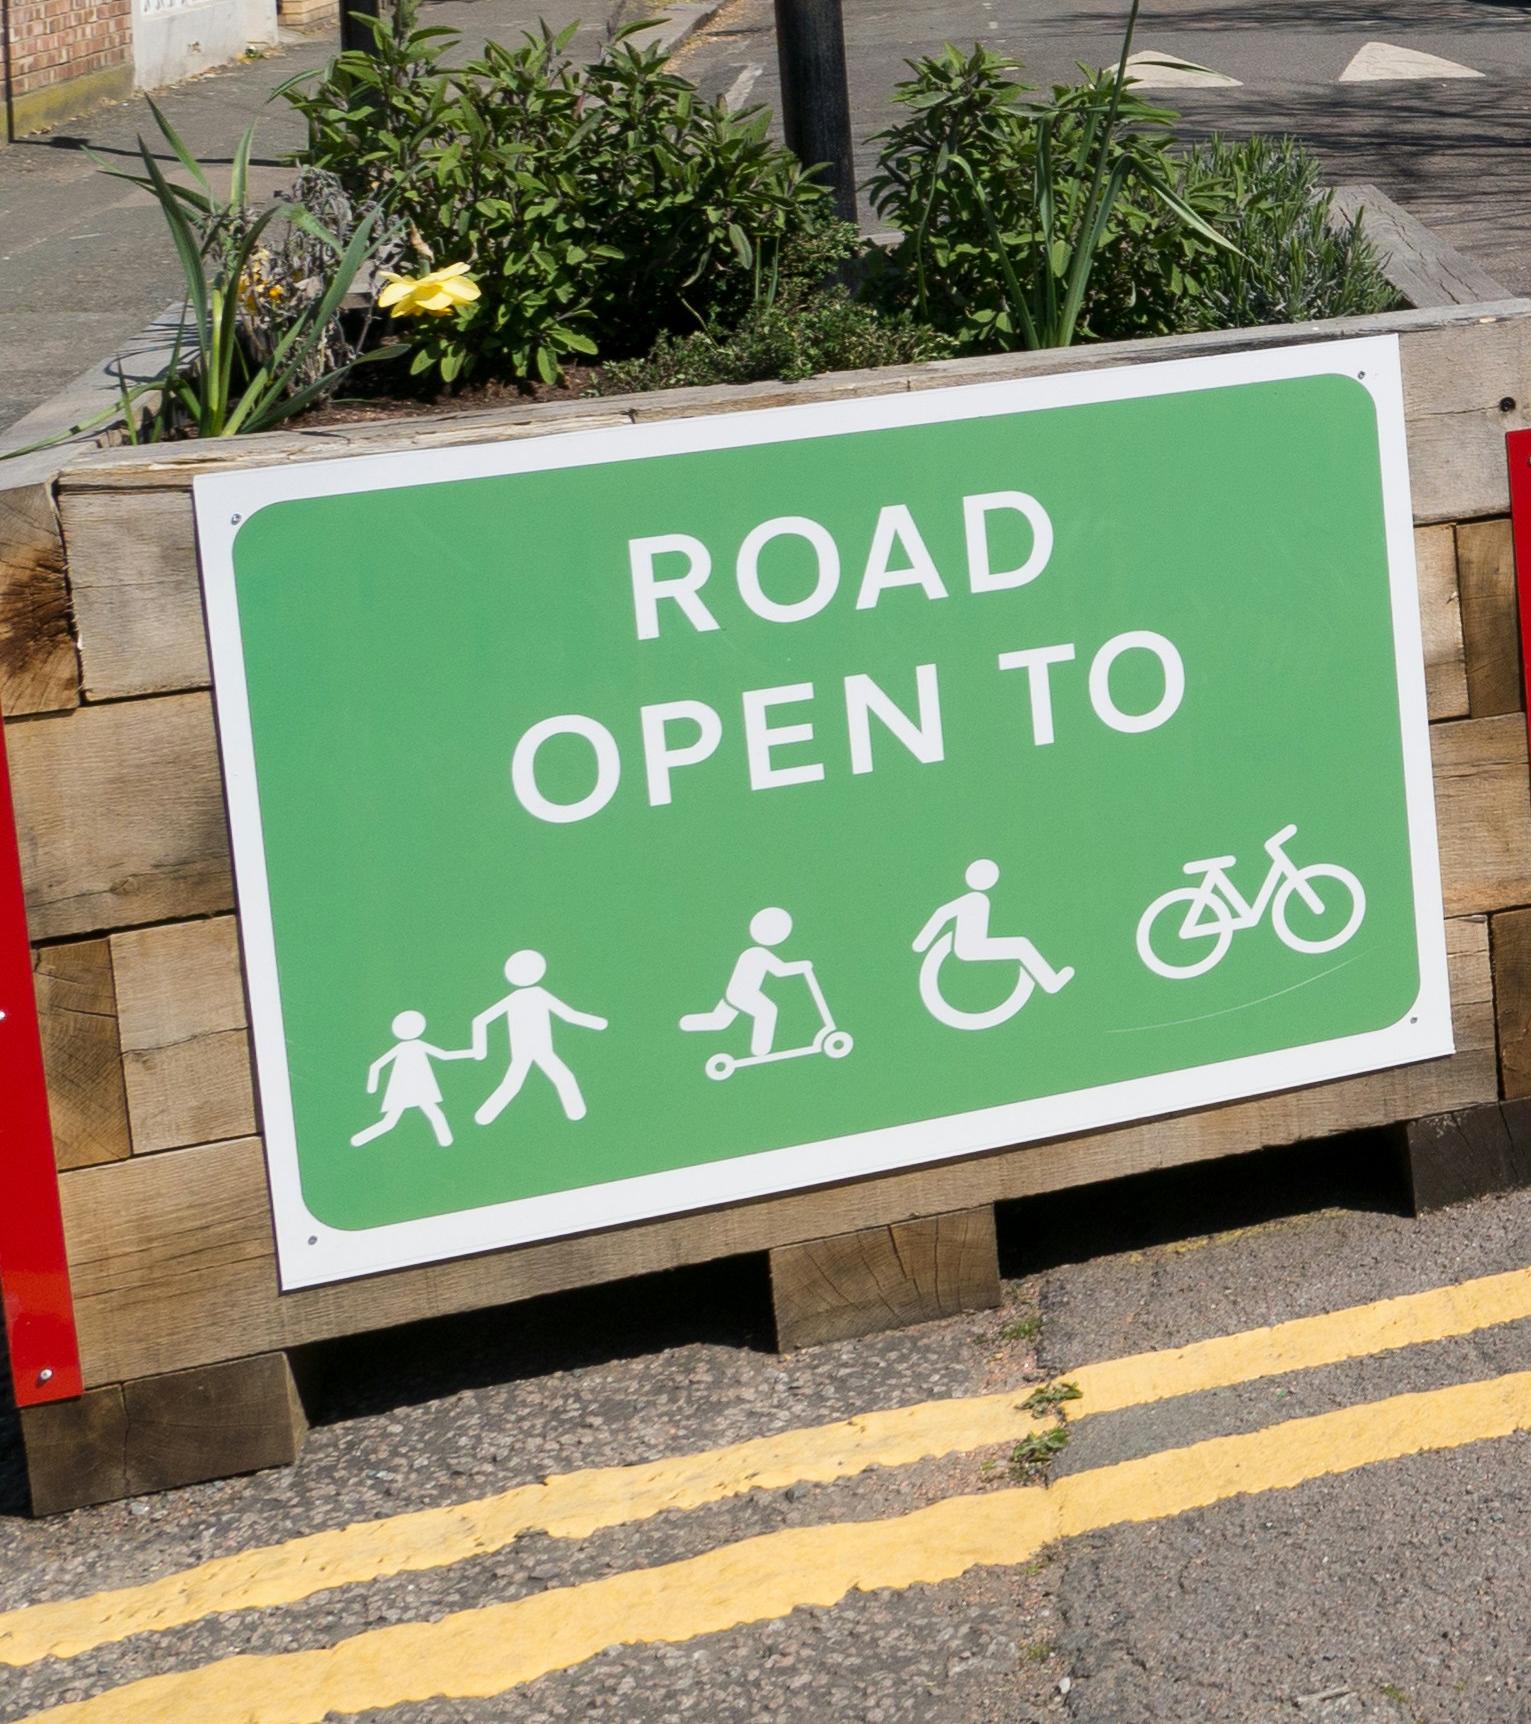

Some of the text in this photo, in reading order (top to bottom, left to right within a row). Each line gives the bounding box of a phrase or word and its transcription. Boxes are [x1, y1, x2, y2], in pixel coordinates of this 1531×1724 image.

[629, 491, 1053, 639] ROAD
[512, 631, 1184, 822] OPEN TO
